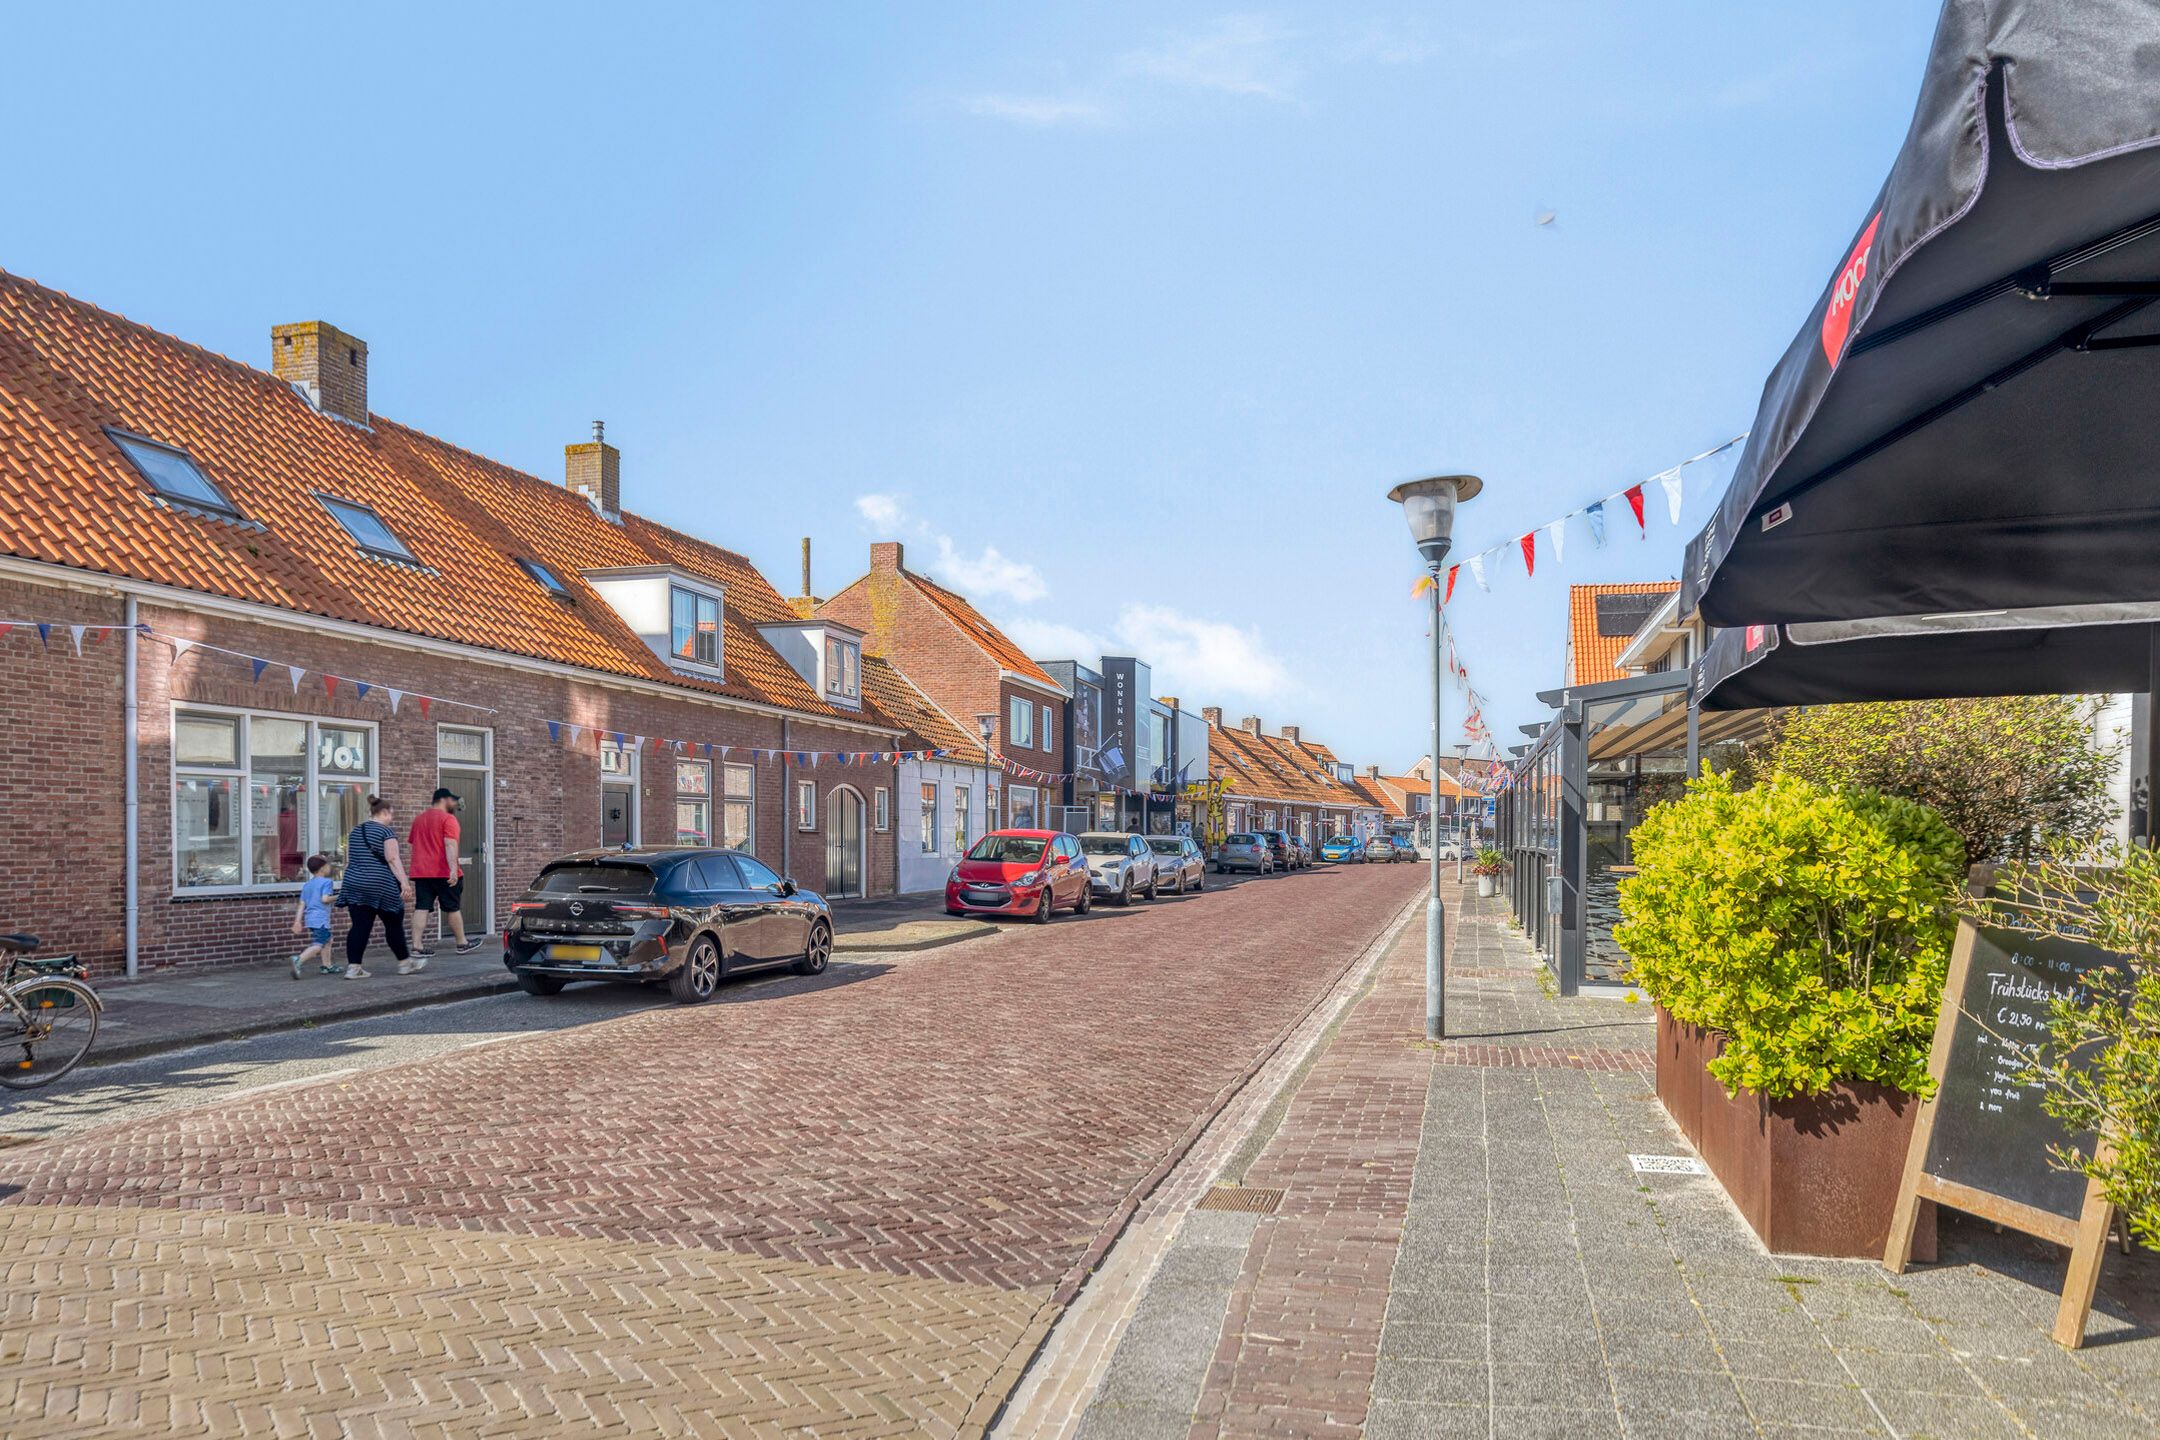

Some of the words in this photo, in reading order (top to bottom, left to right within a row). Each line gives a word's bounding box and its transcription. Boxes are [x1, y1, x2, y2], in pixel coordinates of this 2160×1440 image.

[1116, 673, 1125, 714] WONEN
[1116, 718, 1124, 726] &
[2011, 952, 2034, 966] 8:00
[2048, 959, 2071, 972] 11:00
[2008, 1011, 2032, 1028] 21,50
